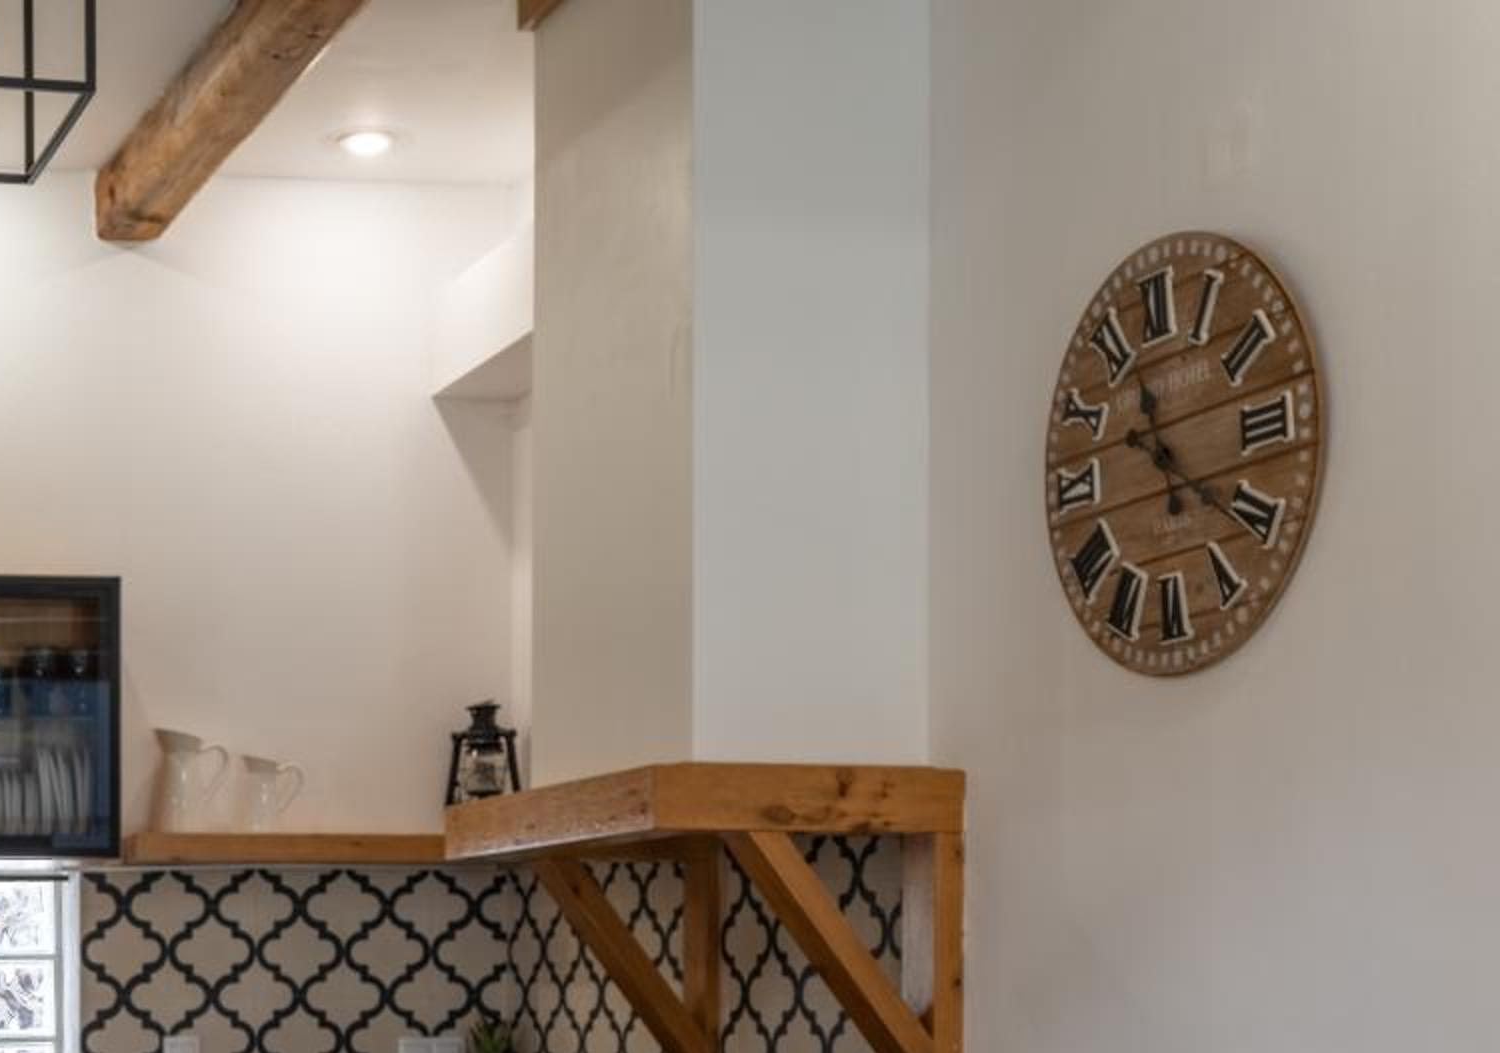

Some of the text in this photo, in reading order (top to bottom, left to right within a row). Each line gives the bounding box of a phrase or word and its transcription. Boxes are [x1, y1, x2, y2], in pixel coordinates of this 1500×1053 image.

[1137, 266, 1177, 348] XII
[1188, 269, 1224, 345] I
[1090, 307, 1137, 387] XI
[1221, 309, 1275, 386] II
[1062, 388, 1108, 440] X
[1240, 390, 1294, 456] III
[1058, 457, 1100, 515] IX
[1228, 480, 1286, 549] IV
[1159, 571, 1194, 645] VI
[1206, 541, 1247, 610] V
